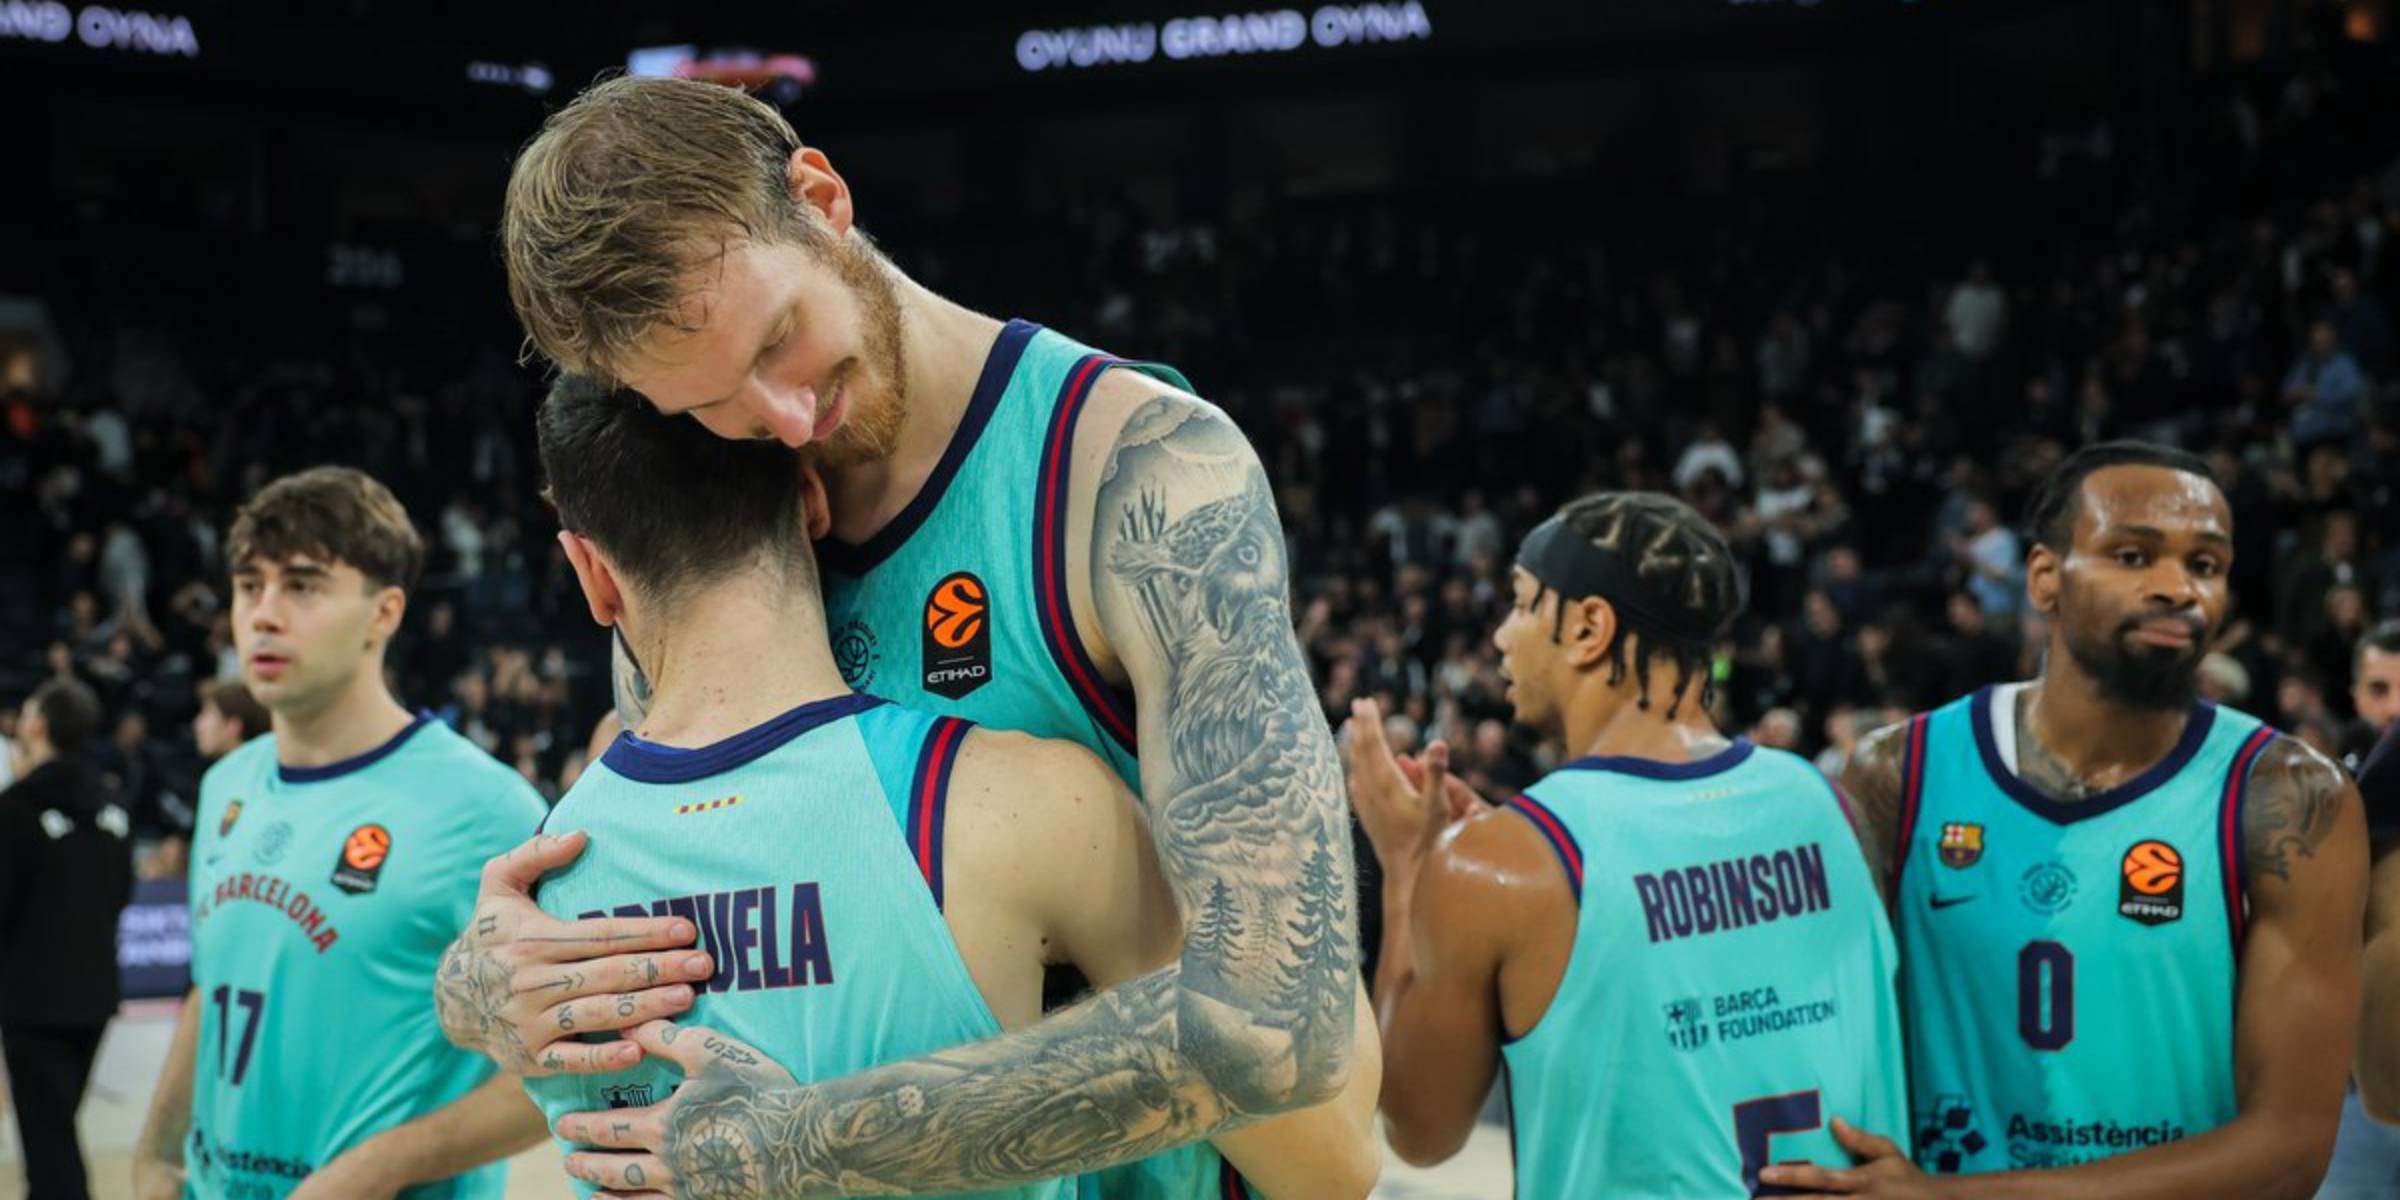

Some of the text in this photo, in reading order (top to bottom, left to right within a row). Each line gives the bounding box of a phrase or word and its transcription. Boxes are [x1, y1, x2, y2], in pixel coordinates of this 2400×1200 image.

[77, 4, 200, 57] OYNA
[1161, 8, 1306, 59] GRAND
[1311, 0, 1432, 47] OYNA
[927, 664, 986, 684] ETIHAD
[214, 872, 340, 955] BARCELONA
[1633, 842, 1832, 944] ROBINSON
[577, 881, 834, 996] UELA
[1713, 985, 1779, 1017] BARÇA
[1717, 1000, 1837, 1042] FOUNDATION
[2017, 939, 2074, 1052] 0
[212, 984, 265, 1086] 17
[2007, 1113, 2185, 1148] Assistència
